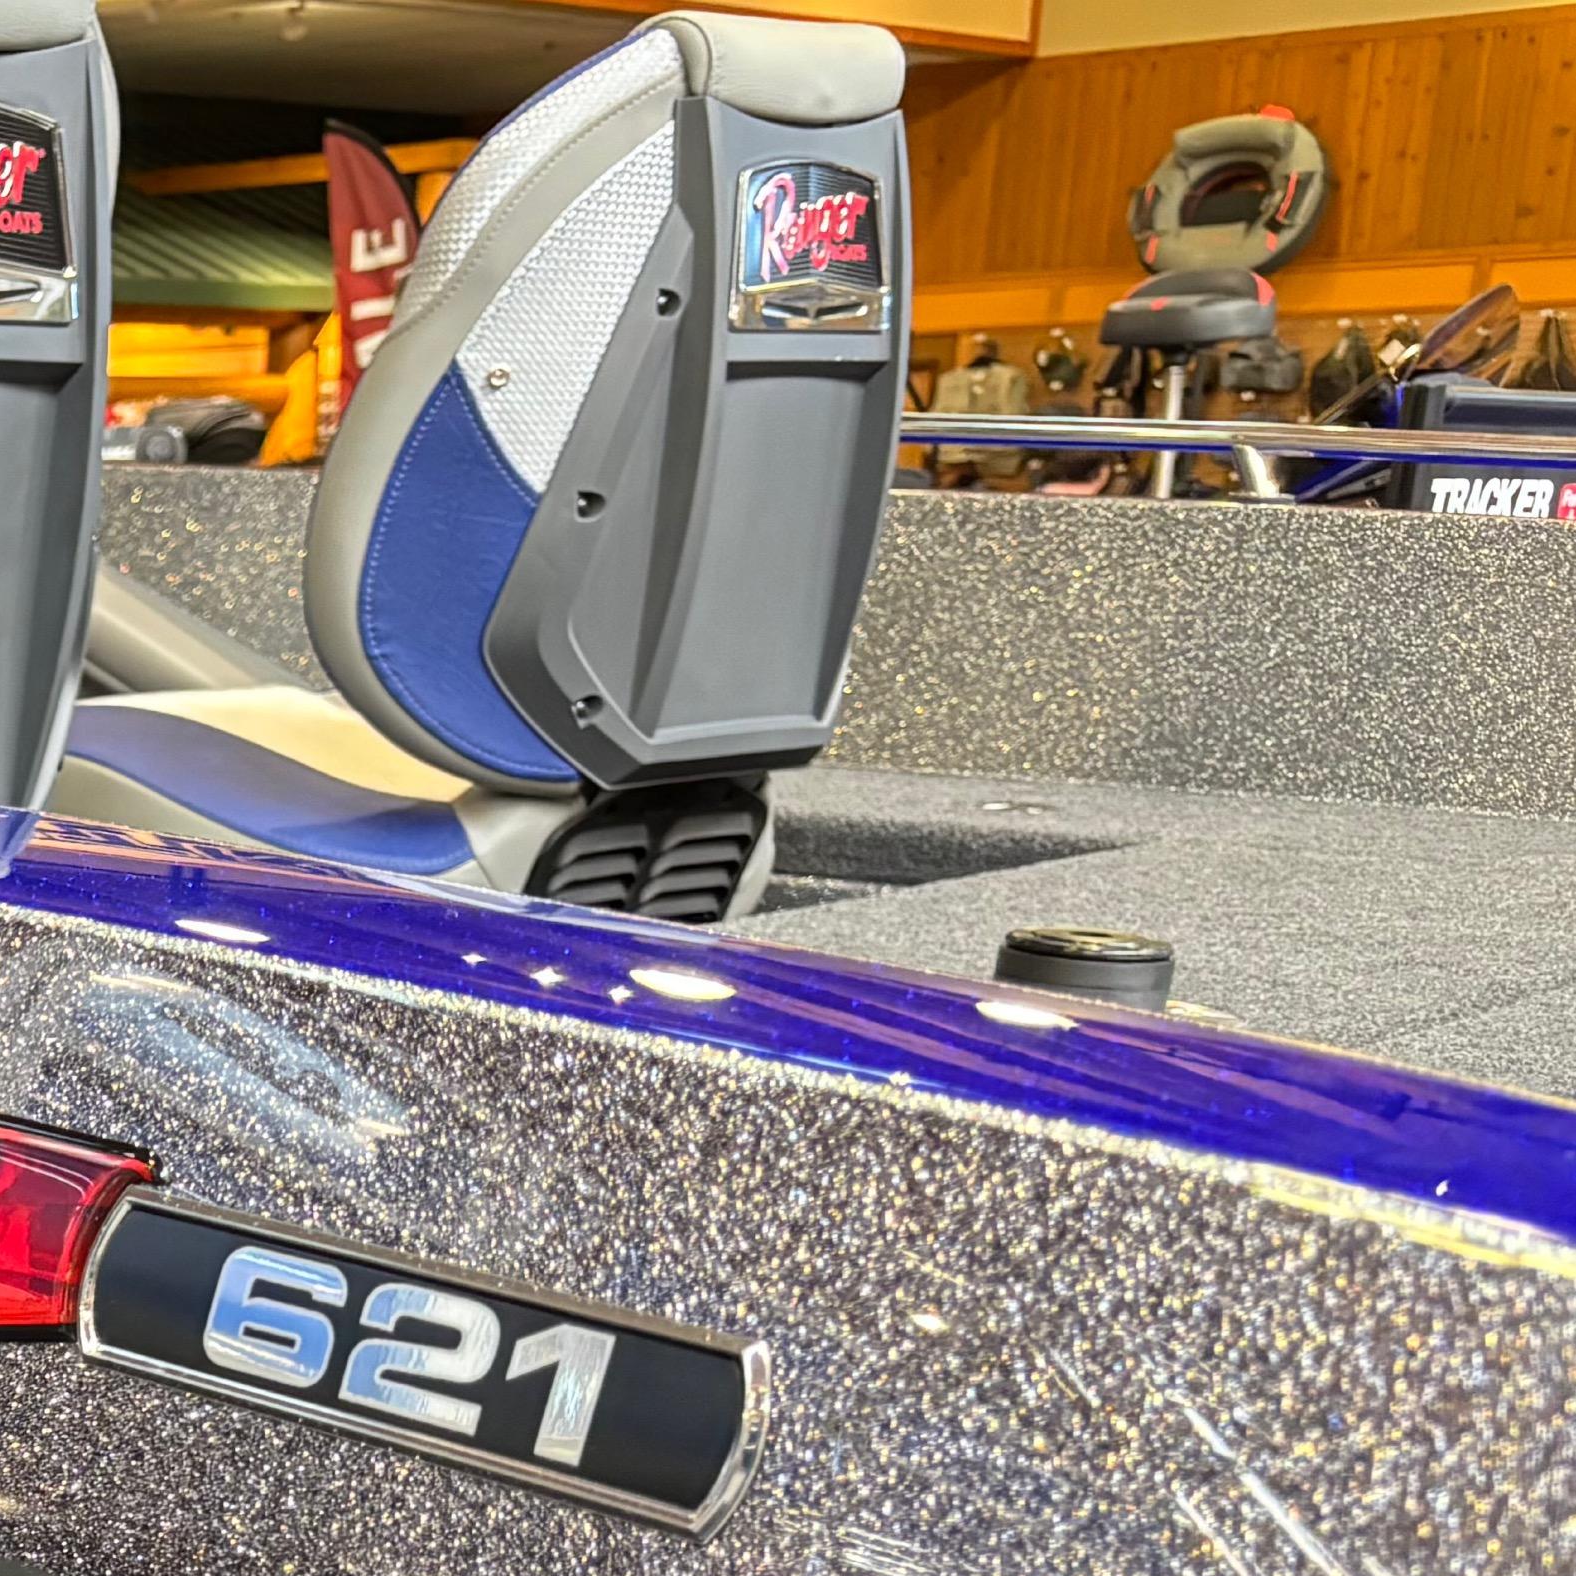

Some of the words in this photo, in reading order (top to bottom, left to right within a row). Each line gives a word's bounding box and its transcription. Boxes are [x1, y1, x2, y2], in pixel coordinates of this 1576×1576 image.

[753, 172, 870, 283] Ranger
[1430, 477, 1555, 518] TRACKER
[202, 1243, 619, 1471] 621
